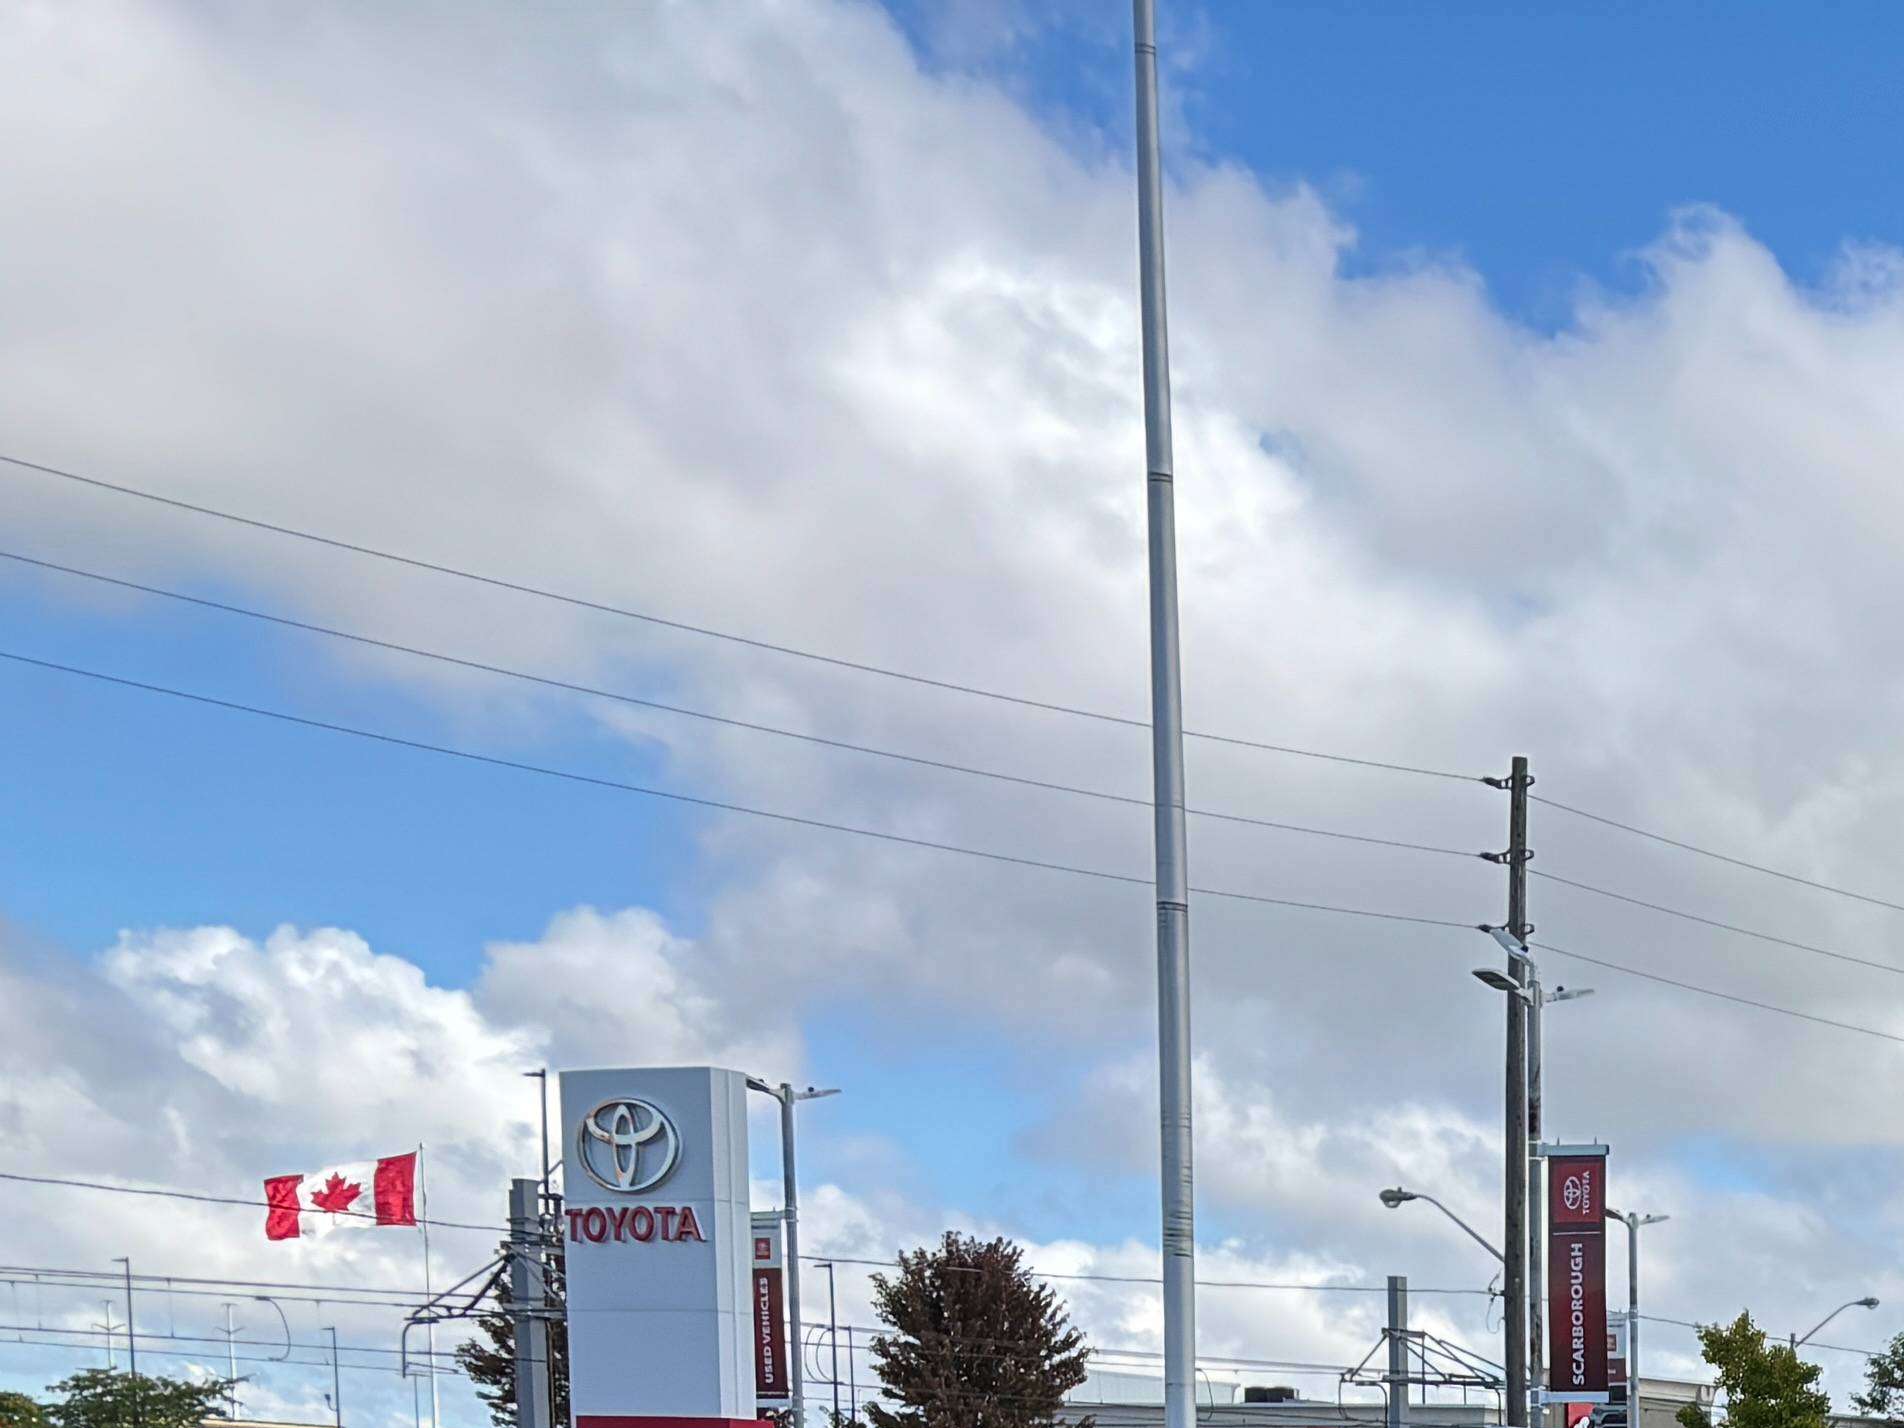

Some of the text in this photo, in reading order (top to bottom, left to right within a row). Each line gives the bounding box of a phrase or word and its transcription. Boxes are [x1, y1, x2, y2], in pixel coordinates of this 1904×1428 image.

[565, 1206, 707, 1243] TOYOTA
[760, 1277, 774, 1384] USED VEHICLES
[1571, 1243, 1585, 1386] SCARBOROUGH
